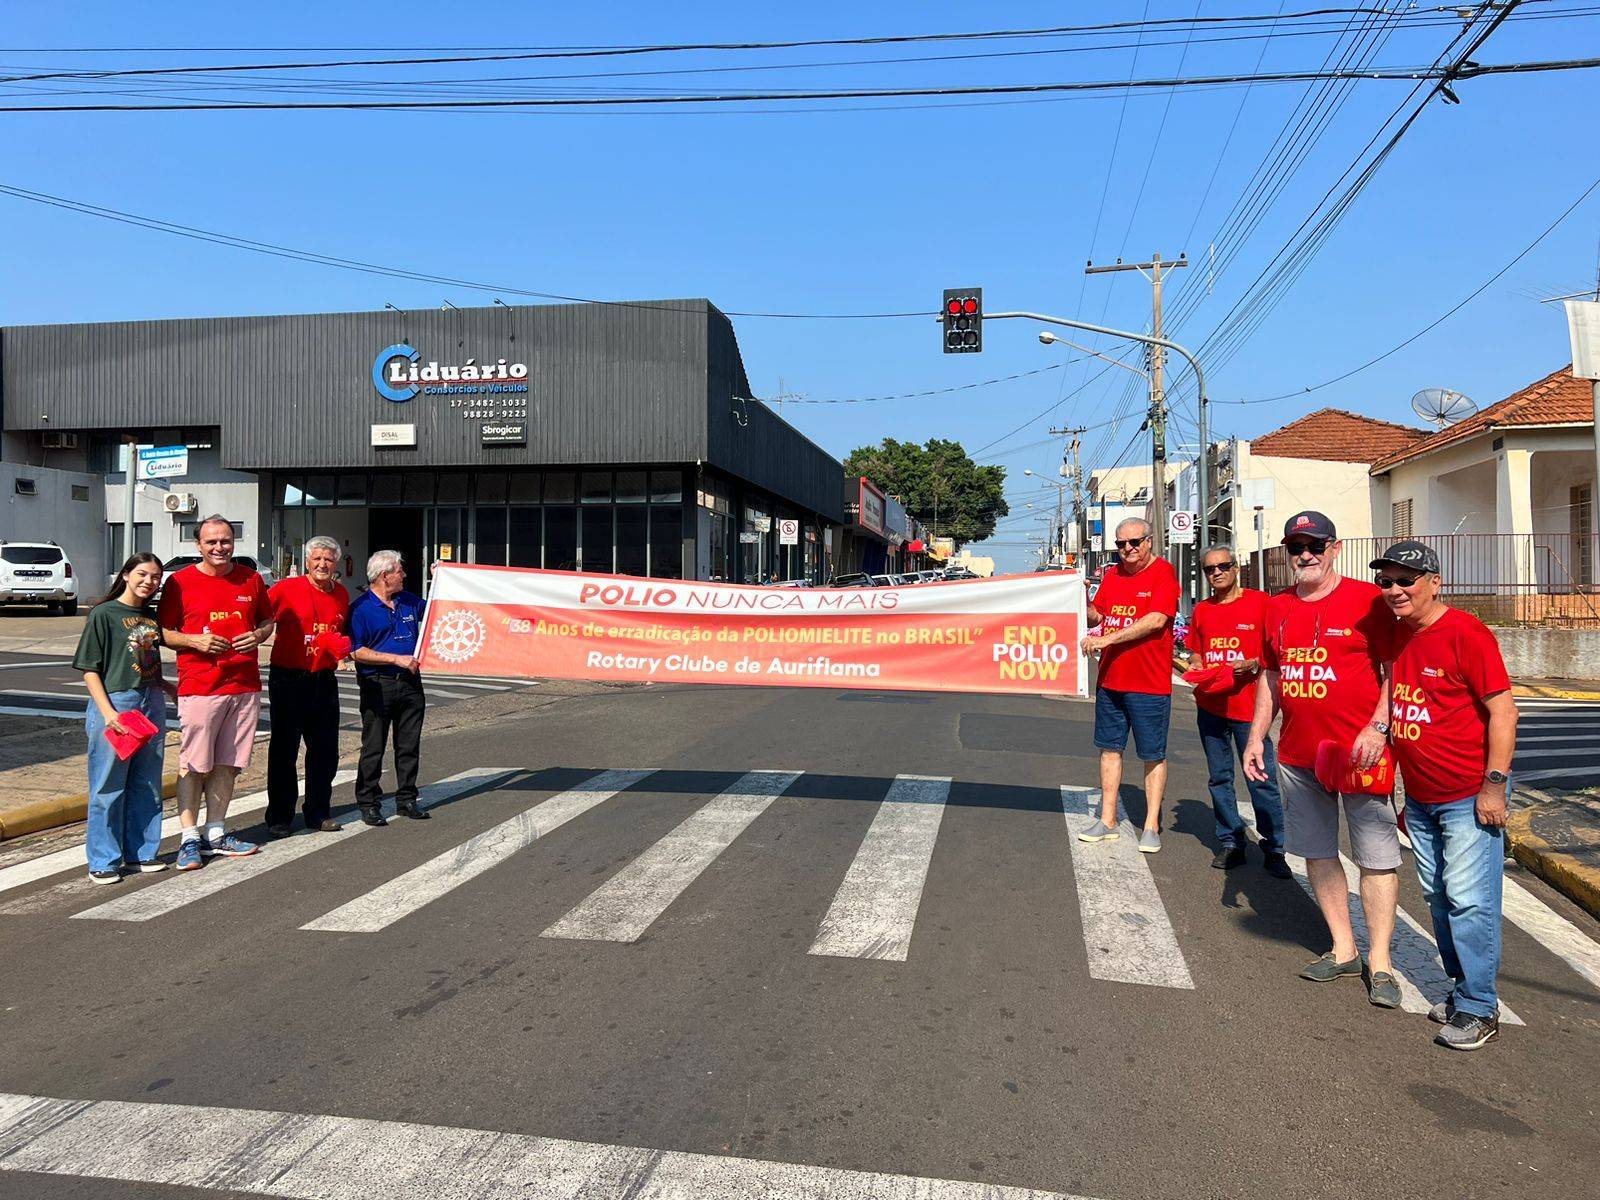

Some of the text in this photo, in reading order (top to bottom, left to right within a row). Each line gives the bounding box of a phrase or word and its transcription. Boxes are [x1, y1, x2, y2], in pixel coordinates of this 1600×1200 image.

[390, 359, 528, 381] Liduário
[482, 425, 521, 436] Sbrogicar
[580, 583, 899, 609] POLIO NUNCA MAIS
[1111, 605, 1137, 616] PELO
[1123, 617, 1138, 627] D
[534, 620, 578, 637] Anos
[582, 622, 603, 637] de
[607, 625, 712, 645] erradicação
[716, 627, 739, 642] da
[742, 627, 872, 644] POLIOMIELITE
[876, 633, 901, 645] no
[1003, 626, 1056, 645] END
[1210, 637, 1240, 649] PELO
[993, 643, 1068, 662] POLIO
[1206, 650, 1245, 663] FIM DA
[1286, 647, 1328, 663] PELO
[586, 650, 880, 677] Rotary Clube de Auriflama
[1000, 661, 1060, 680] NOW
[1280, 665, 1337, 681] FIM DA
[1282, 681, 1328, 699] POLIO
[1406, 705, 1431, 723] DA
[1391, 720, 1421, 741] OLIO
